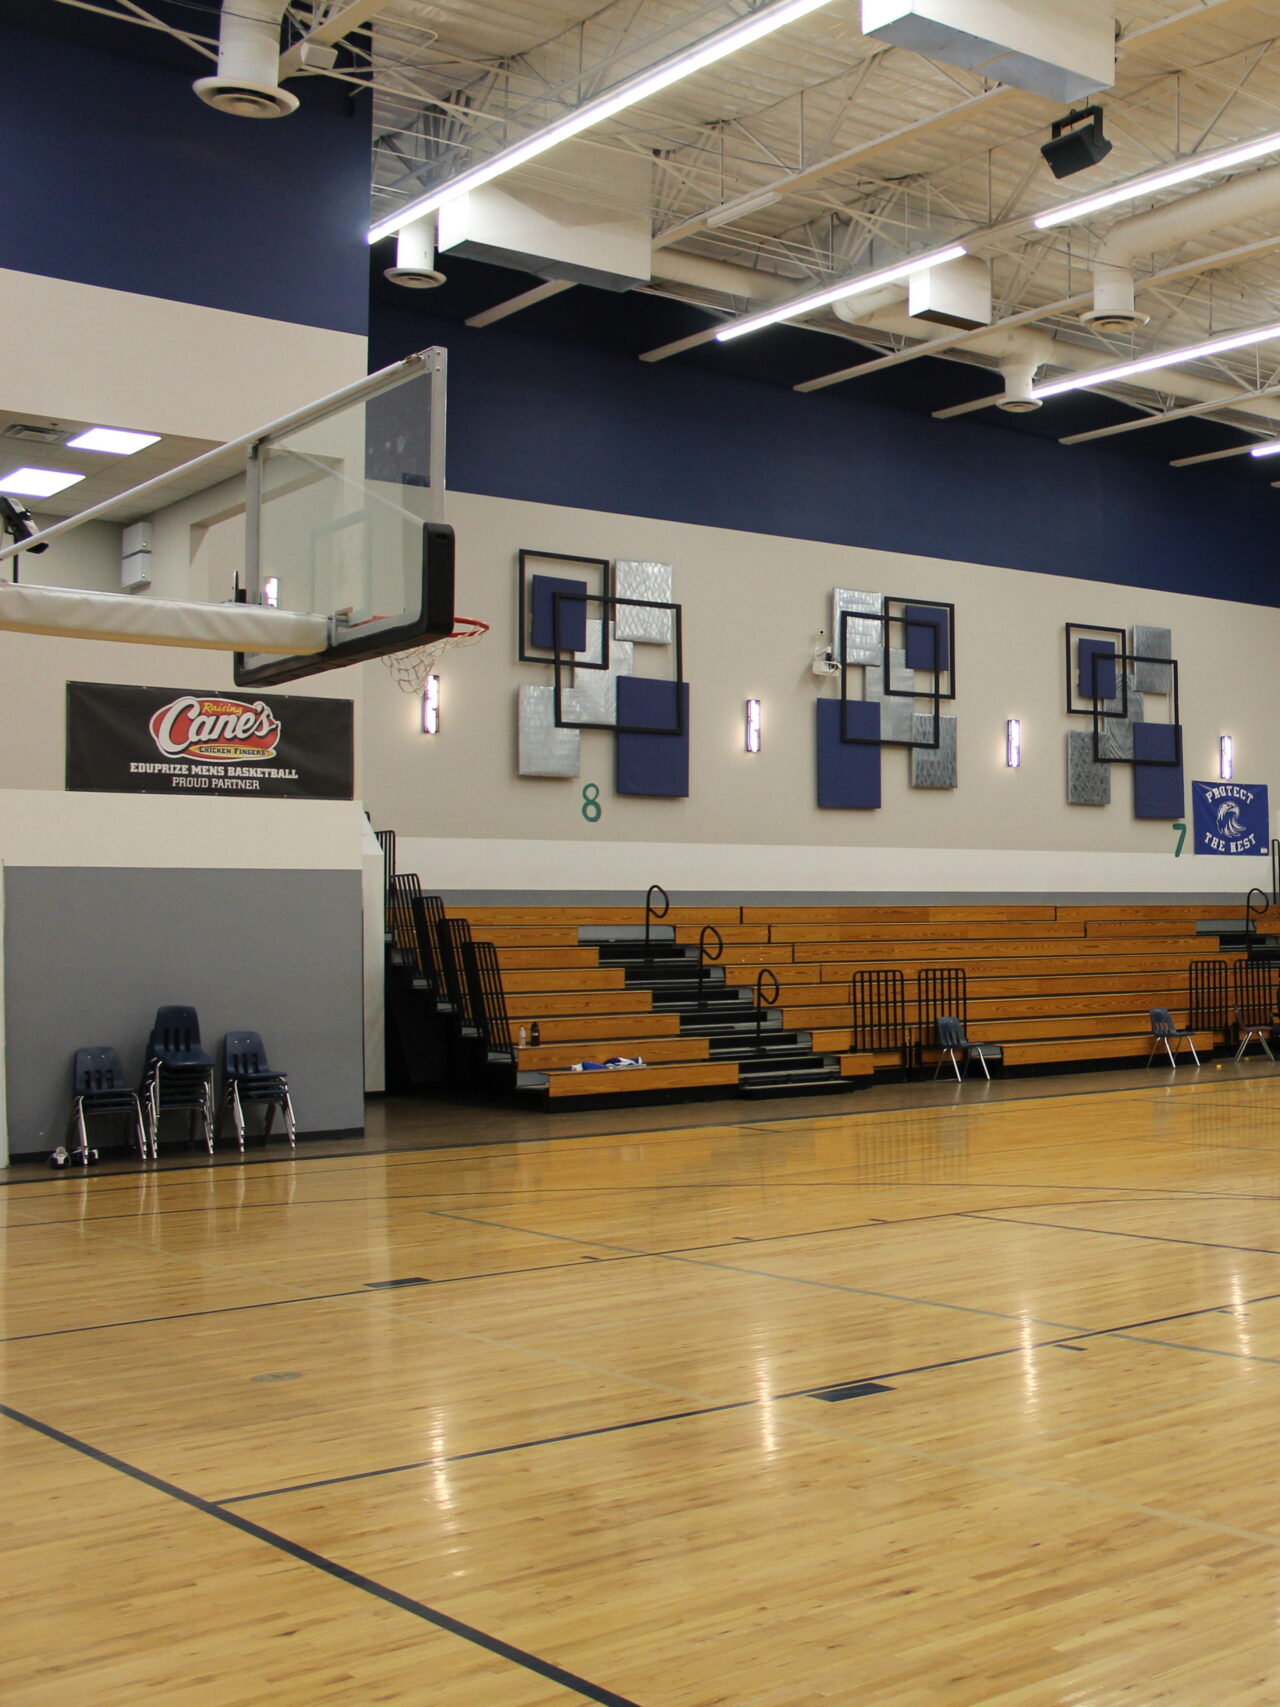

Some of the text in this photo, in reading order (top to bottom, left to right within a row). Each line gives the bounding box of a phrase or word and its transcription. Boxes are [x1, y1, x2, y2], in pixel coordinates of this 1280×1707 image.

[202, 702, 243, 716] Raising
[158, 698, 278, 752] Cane's
[199, 746, 266, 756] CHICKEN FINGERS
[130, 763, 298, 779] EDUPRIZE MENS BASKETBALL
[172, 777, 260, 790] PROUD PARTNER
[582, 783, 601, 823] 8
[1205, 786, 1254, 804] PROTECT
[1172, 823, 1187, 857] 7
[1204, 832, 1256, 853] THE NEST
